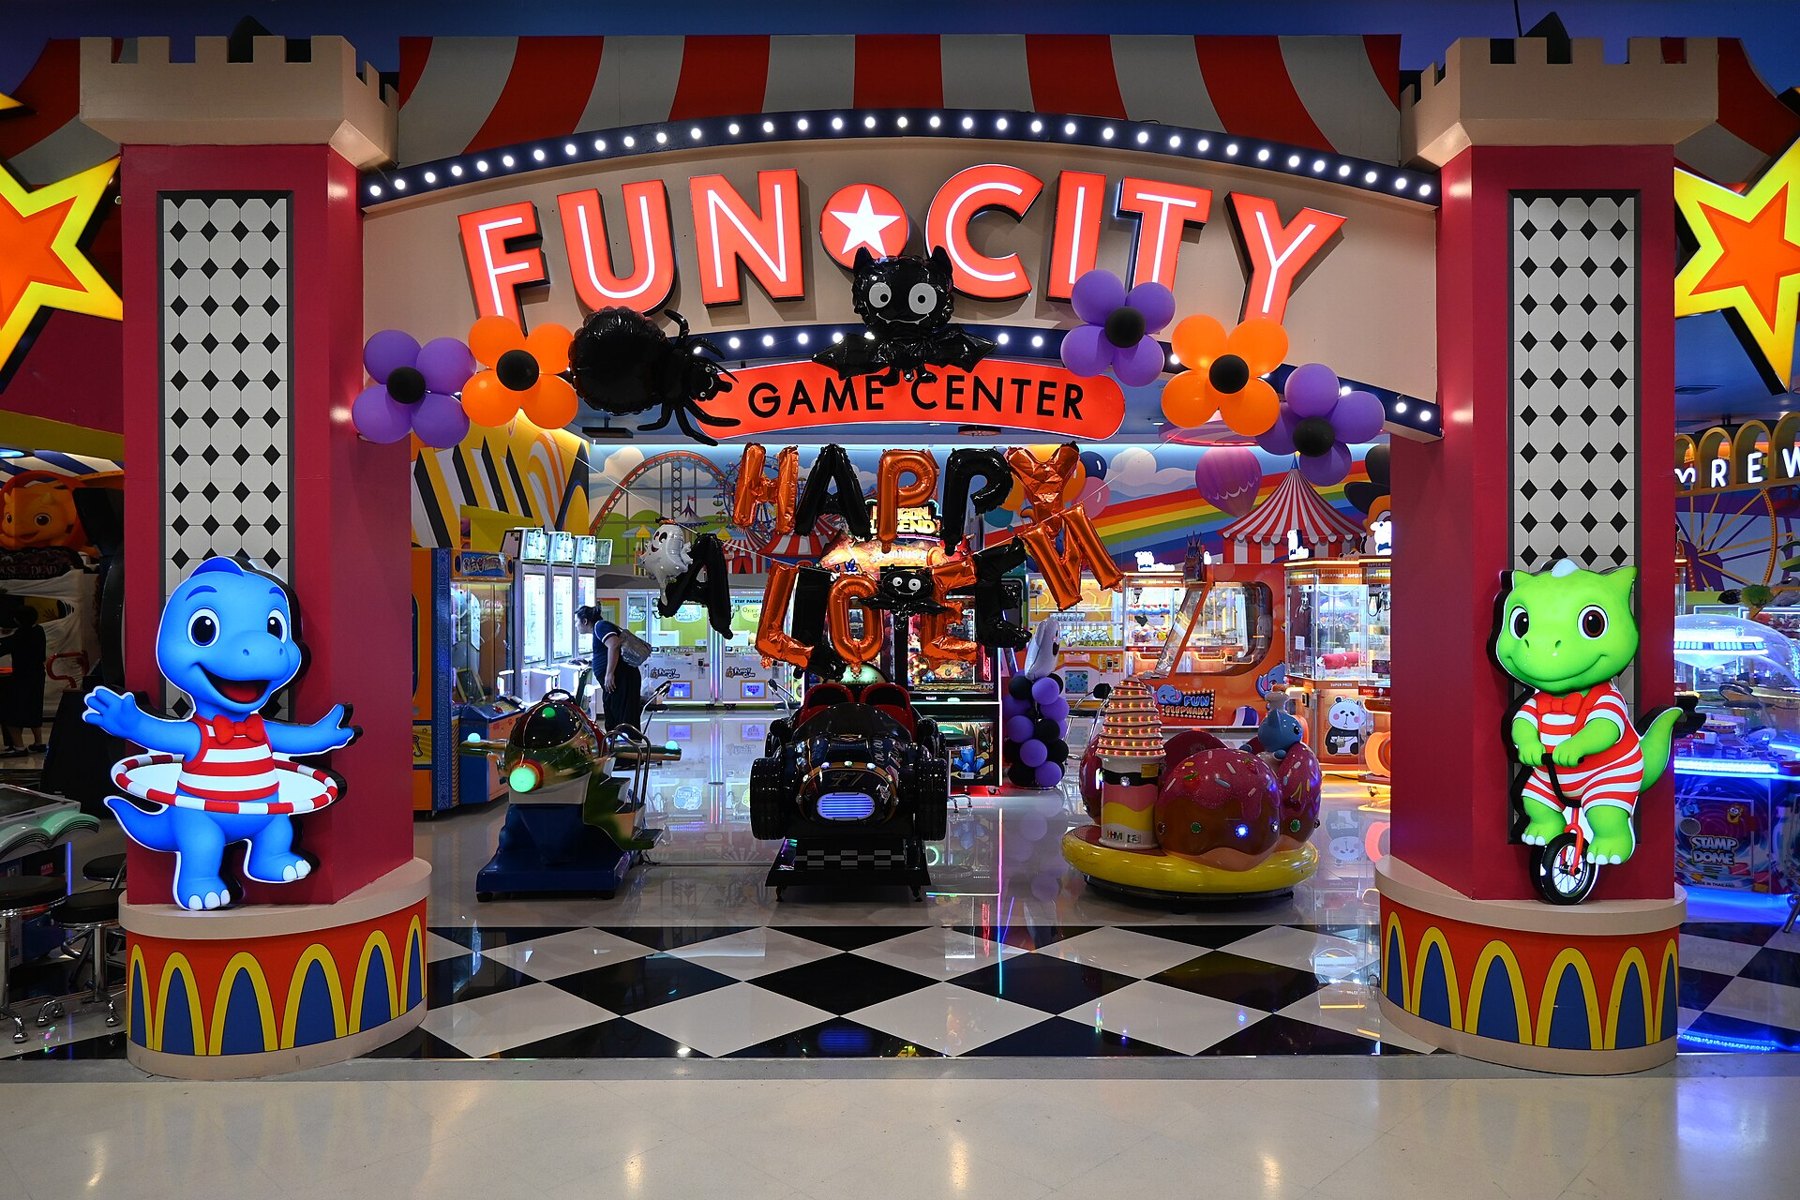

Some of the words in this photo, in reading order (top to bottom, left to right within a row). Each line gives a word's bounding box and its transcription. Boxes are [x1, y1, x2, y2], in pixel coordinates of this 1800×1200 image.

[458, 169, 805, 335] FUN
[924, 163, 1347, 325] CITY
[748, 376, 885, 418] GAME
[911, 375, 1084, 420] CENTER
[732, 442, 1080, 556] HAPPY
[1183, 695, 1210, 707] FUN
[1691, 836, 1738, 851] STAMP
[1693, 850, 1735, 865] DOME
